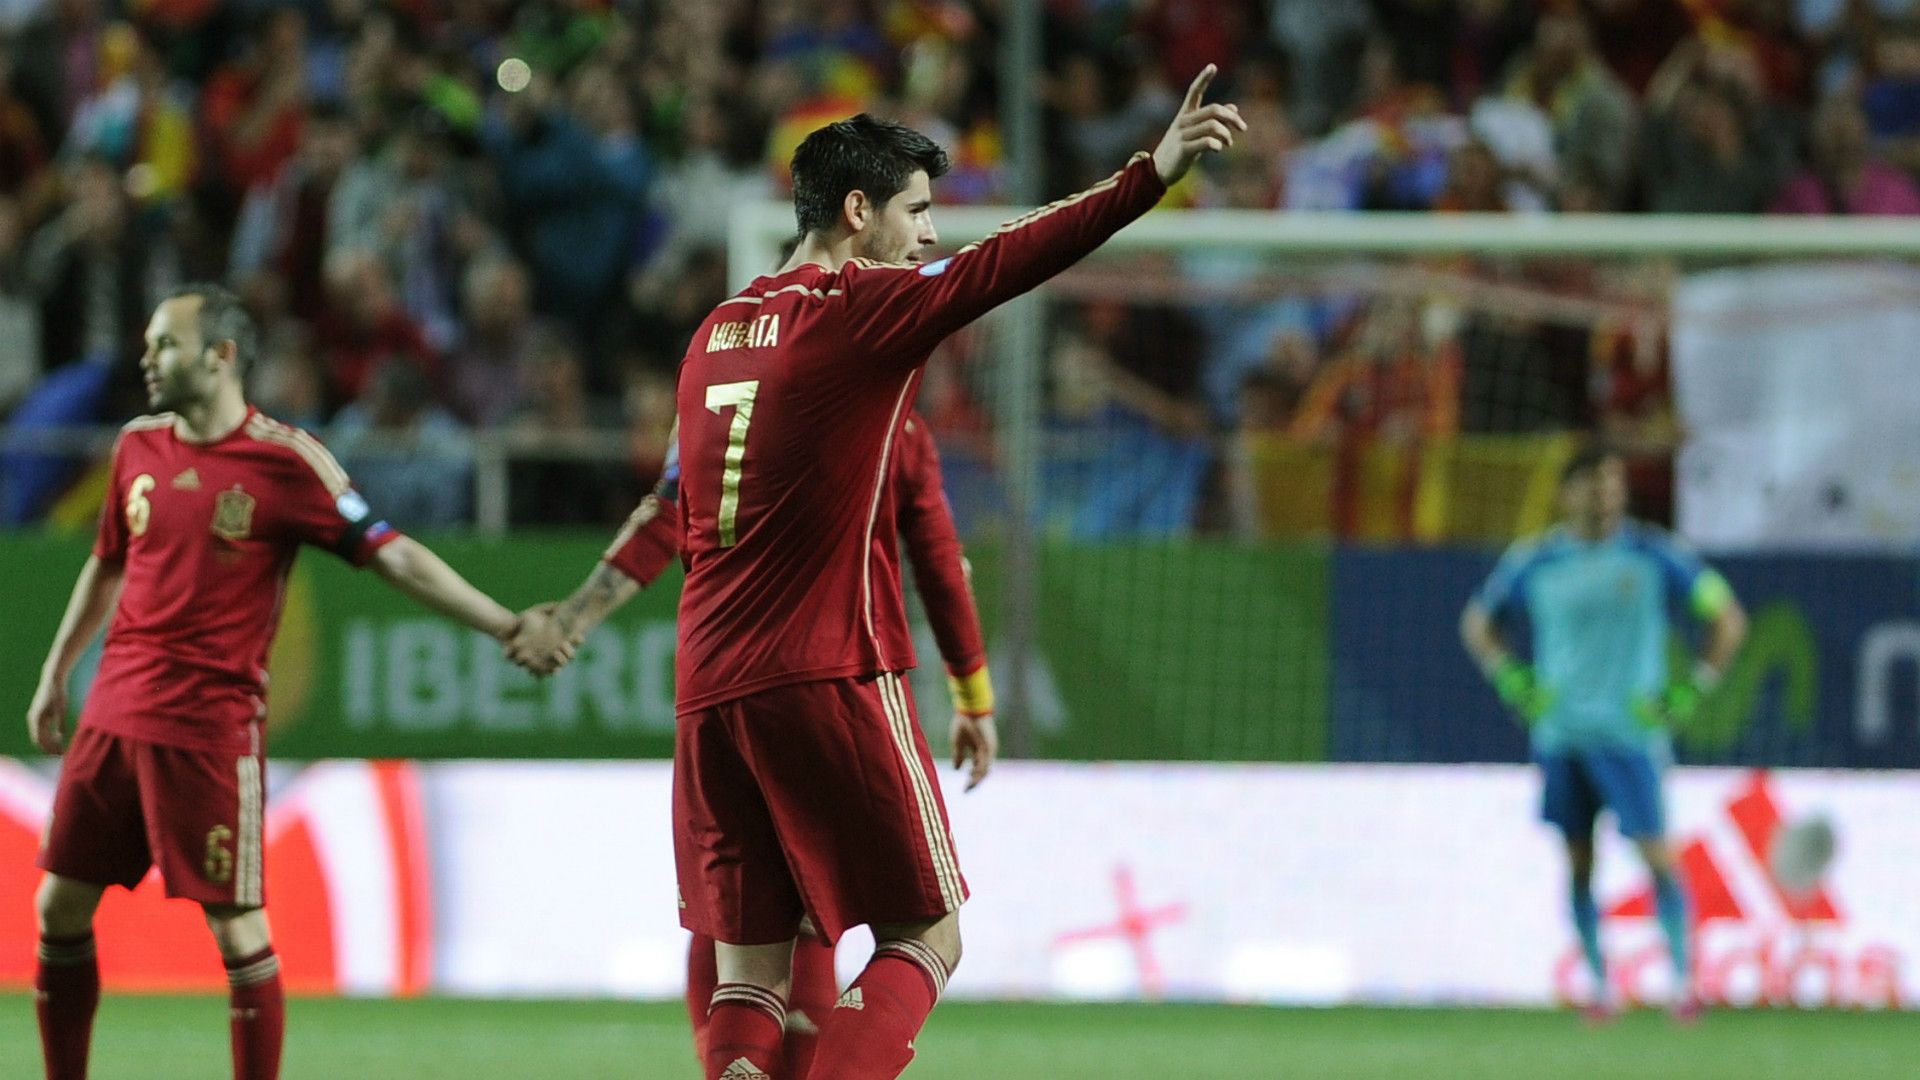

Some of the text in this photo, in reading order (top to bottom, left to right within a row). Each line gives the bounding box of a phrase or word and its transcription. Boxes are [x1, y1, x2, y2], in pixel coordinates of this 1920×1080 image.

[706, 314, 779, 353] MORATA
[705, 380, 759, 548] 7
[127, 474, 156, 537] 6
[205, 824, 232, 884] 6
